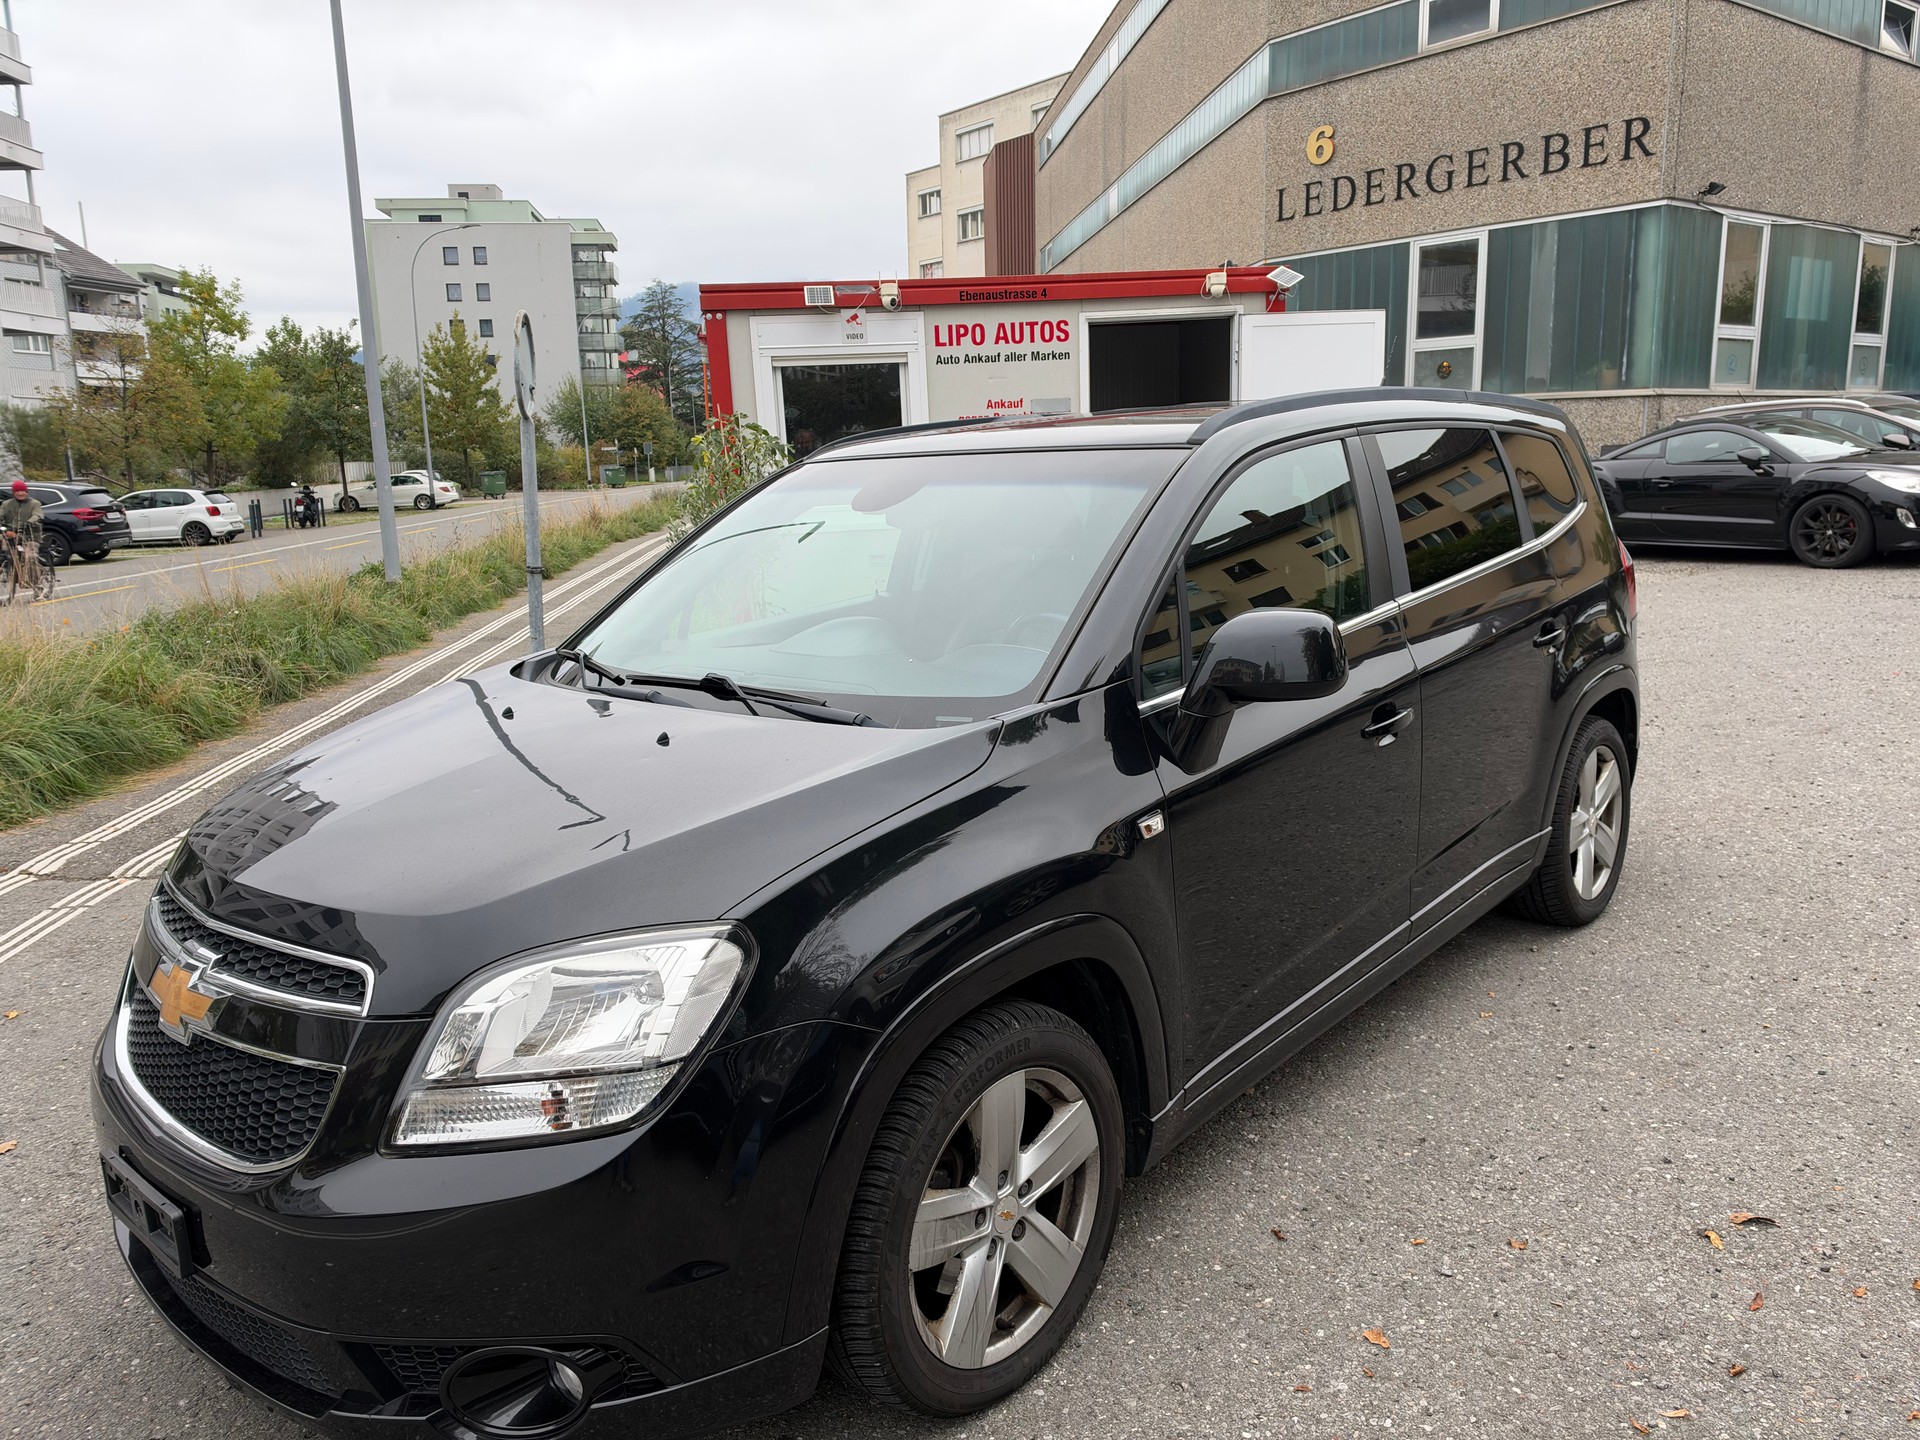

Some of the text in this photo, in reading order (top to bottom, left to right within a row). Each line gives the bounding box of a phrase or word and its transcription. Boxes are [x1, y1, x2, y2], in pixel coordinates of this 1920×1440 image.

[1306, 125, 1334, 165] 6
[1276, 116, 1655, 222] LEDERGERBER
[959, 288, 1047, 301] Ebenaustrasse 4
[934, 319, 1070, 346] LIPO AUTOS
[936, 350, 1070, 365] Auto Ankauf aller Marken
[986, 398, 1024, 410] Ankauf
[954, 1036, 1032, 1104] PERFORMER
